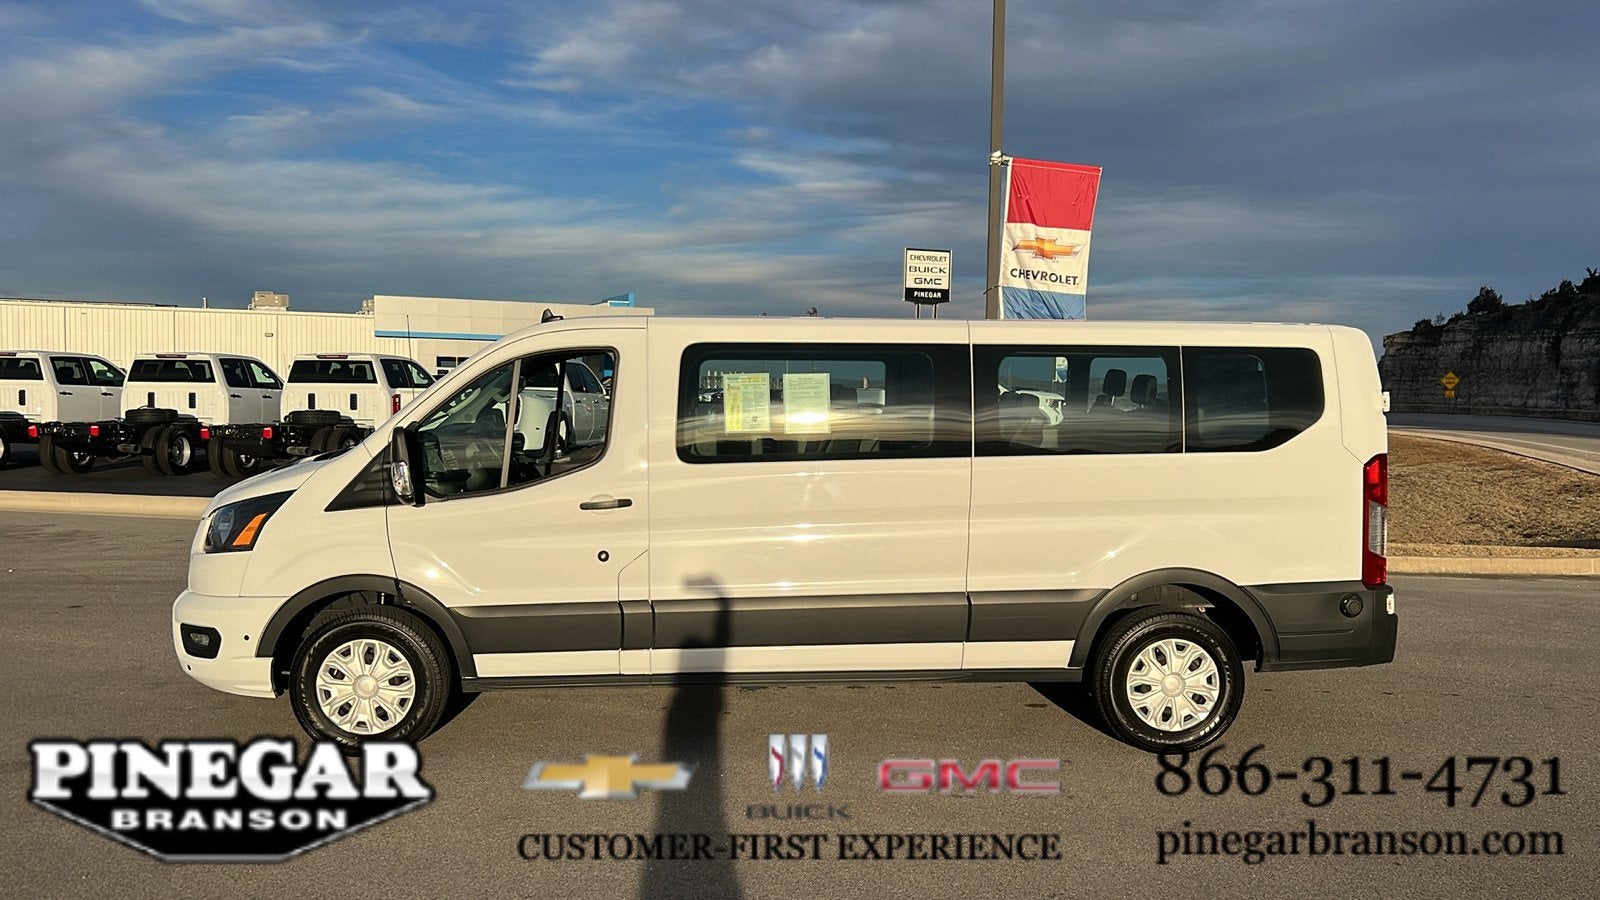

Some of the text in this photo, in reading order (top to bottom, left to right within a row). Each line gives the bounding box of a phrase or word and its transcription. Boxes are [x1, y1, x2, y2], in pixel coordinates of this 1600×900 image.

[910, 254, 947, 262] CHEVROLET
[909, 265, 947, 274] BUICK
[914, 277, 942, 286] GMC
[1010, 268, 1078, 286] CHEVROLET
[913, 290, 942, 299] PINEGAR
